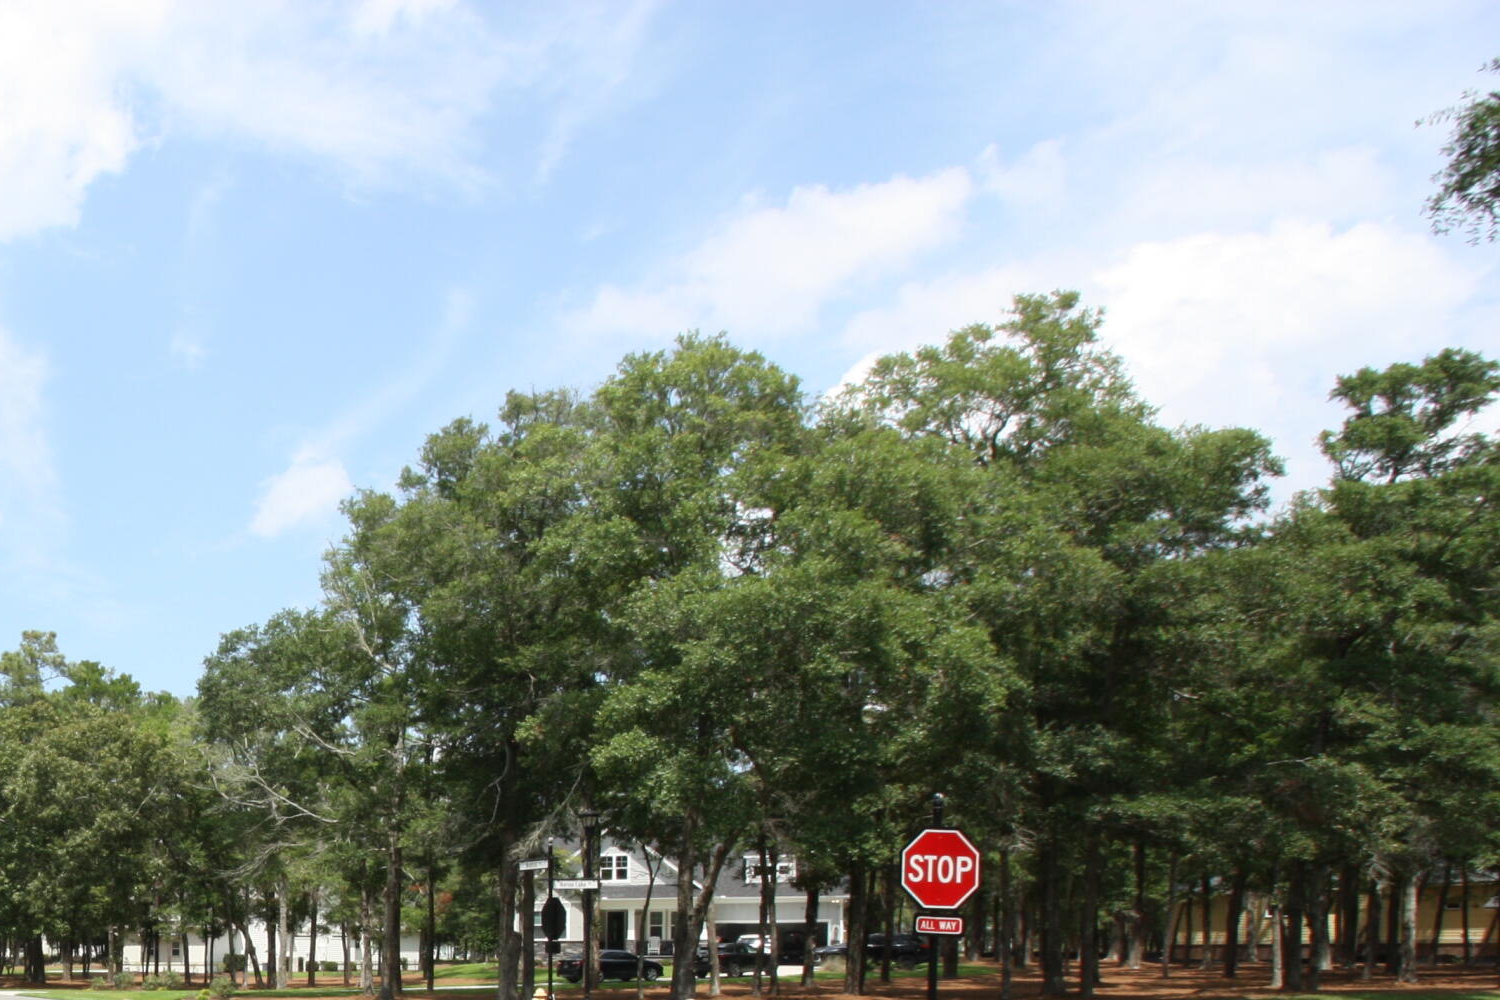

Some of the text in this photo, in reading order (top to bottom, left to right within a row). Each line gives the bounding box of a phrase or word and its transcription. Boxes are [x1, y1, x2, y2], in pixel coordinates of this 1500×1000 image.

[908, 854, 972, 883] STOP
[920, 920, 957, 931] ALL WAY
